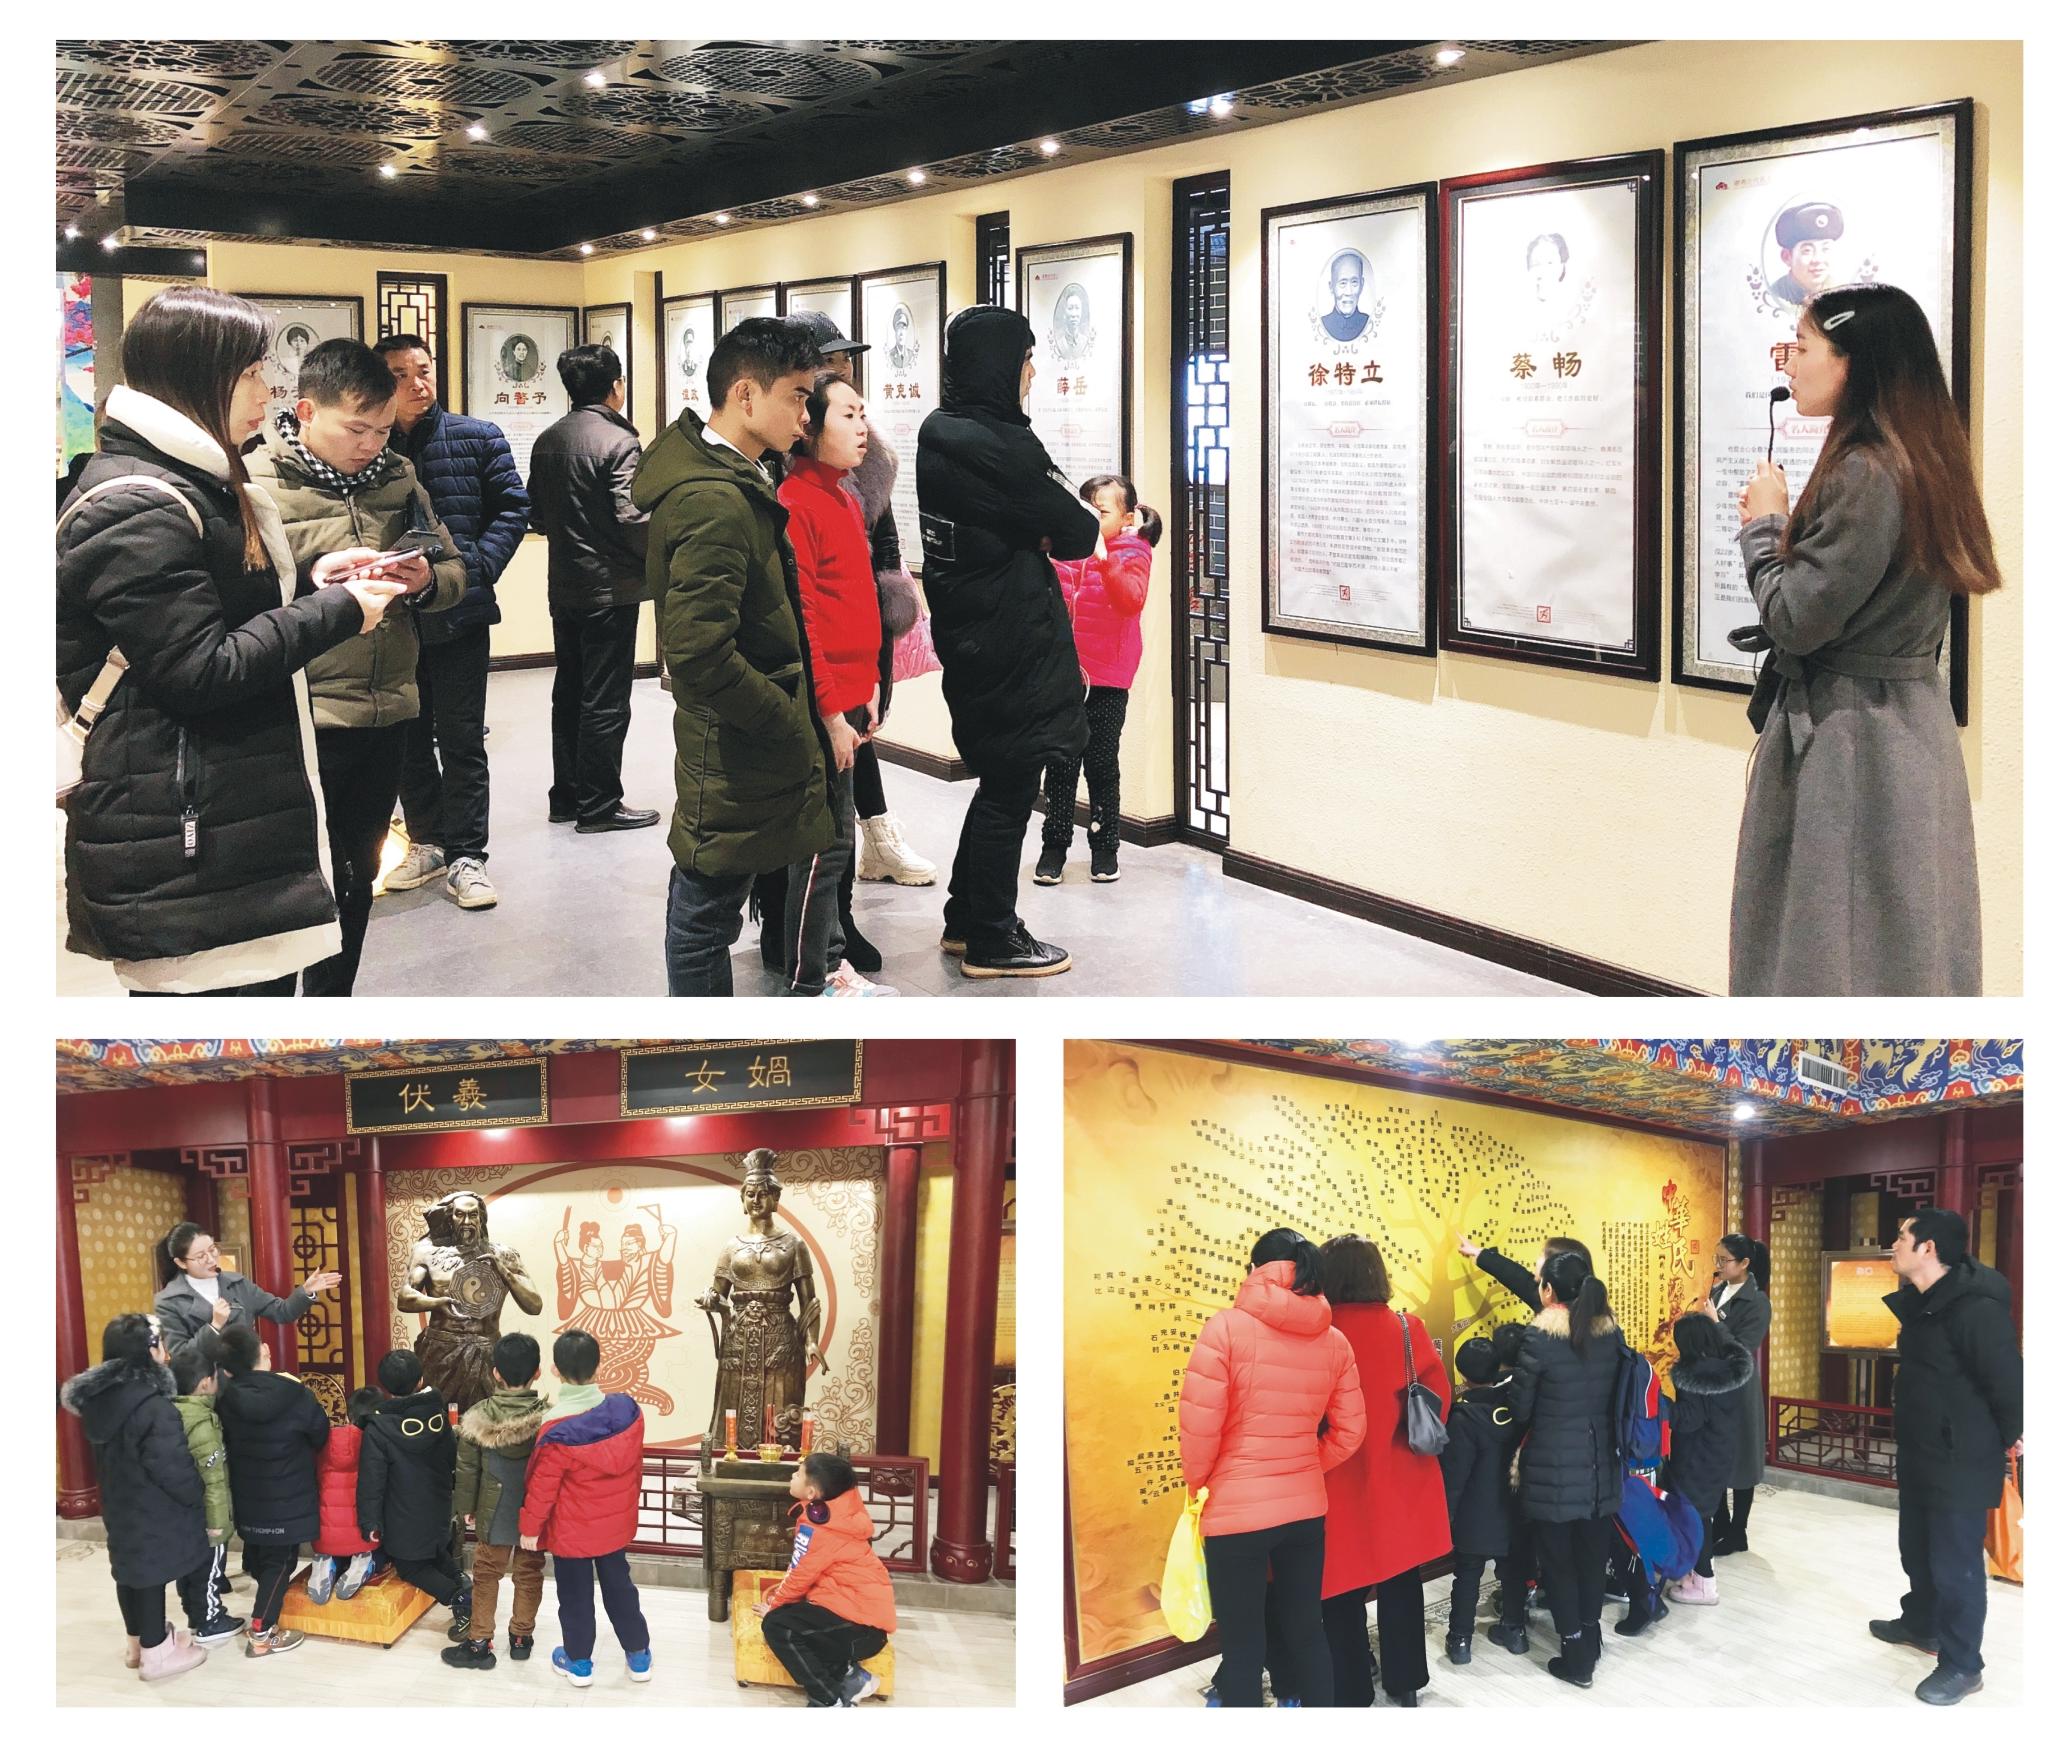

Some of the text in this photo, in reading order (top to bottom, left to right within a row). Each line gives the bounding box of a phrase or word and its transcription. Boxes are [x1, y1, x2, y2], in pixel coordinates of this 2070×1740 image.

[1308, 359, 1384, 387] 徐特立
[1509, 352, 1582, 380] 蔡畅
[883, 382, 921, 400] 黄克诚
[1057, 376, 1088, 396] 薛岳
[494, 391, 547, 406] 向警予
[398, 1077, 488, 1115] 伏羲
